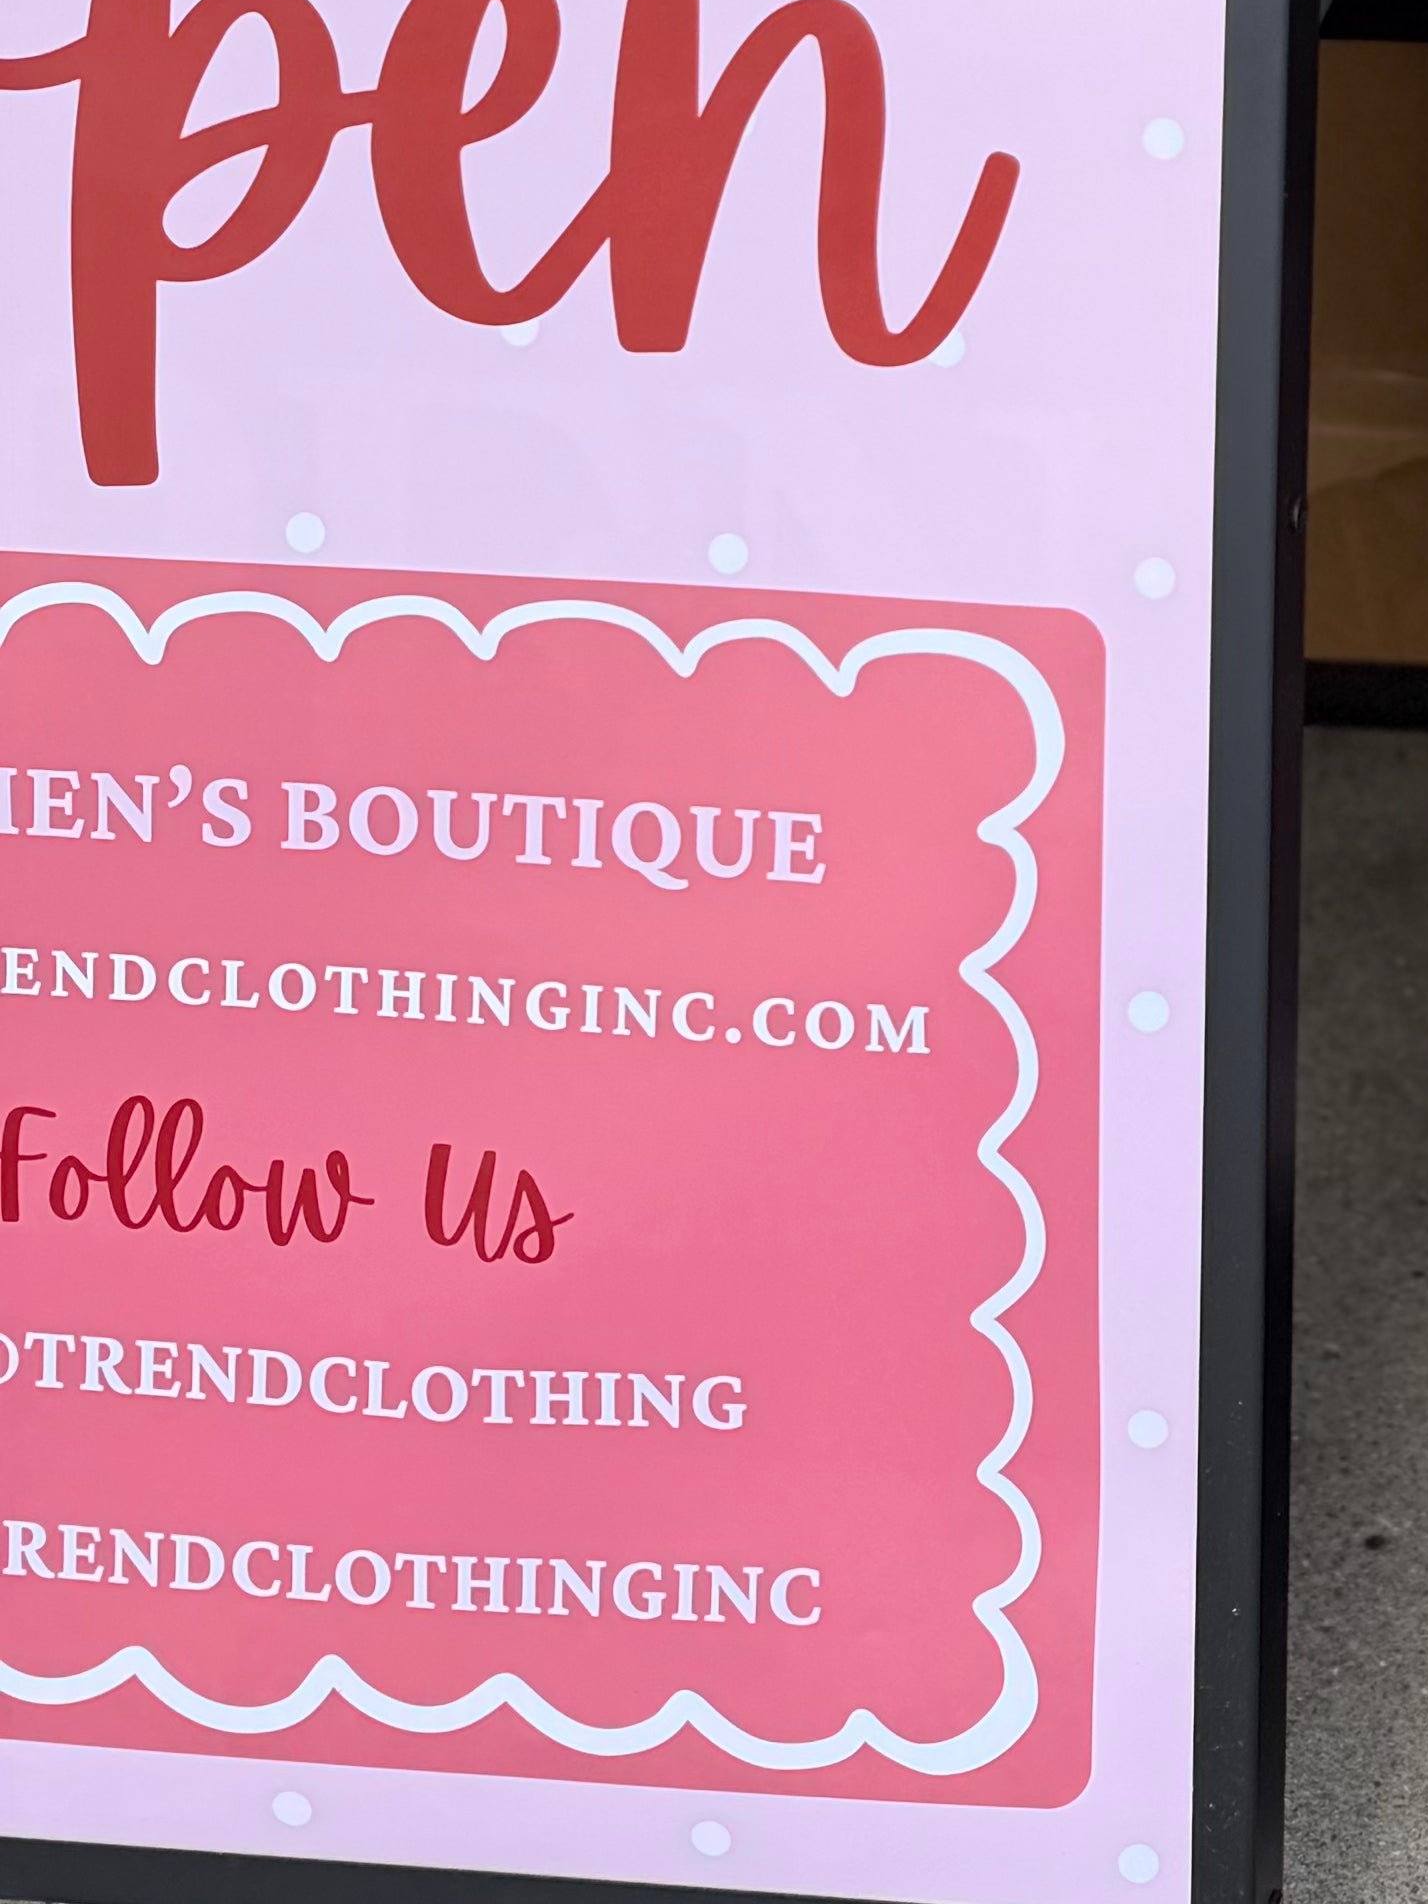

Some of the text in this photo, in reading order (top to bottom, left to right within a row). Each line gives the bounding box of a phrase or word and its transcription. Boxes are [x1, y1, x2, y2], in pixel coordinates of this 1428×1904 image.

[280, 782, 826, 890] BOUTIQUE
[0, 946, 931, 1054] ENDCLOTHINGINC.COM
[0, 1094, 575, 1264] Follow Us
[0, 1331, 747, 1431] TRENDCLOTHING
[2, 1518, 822, 1627] RENDCLOTHINGINC
